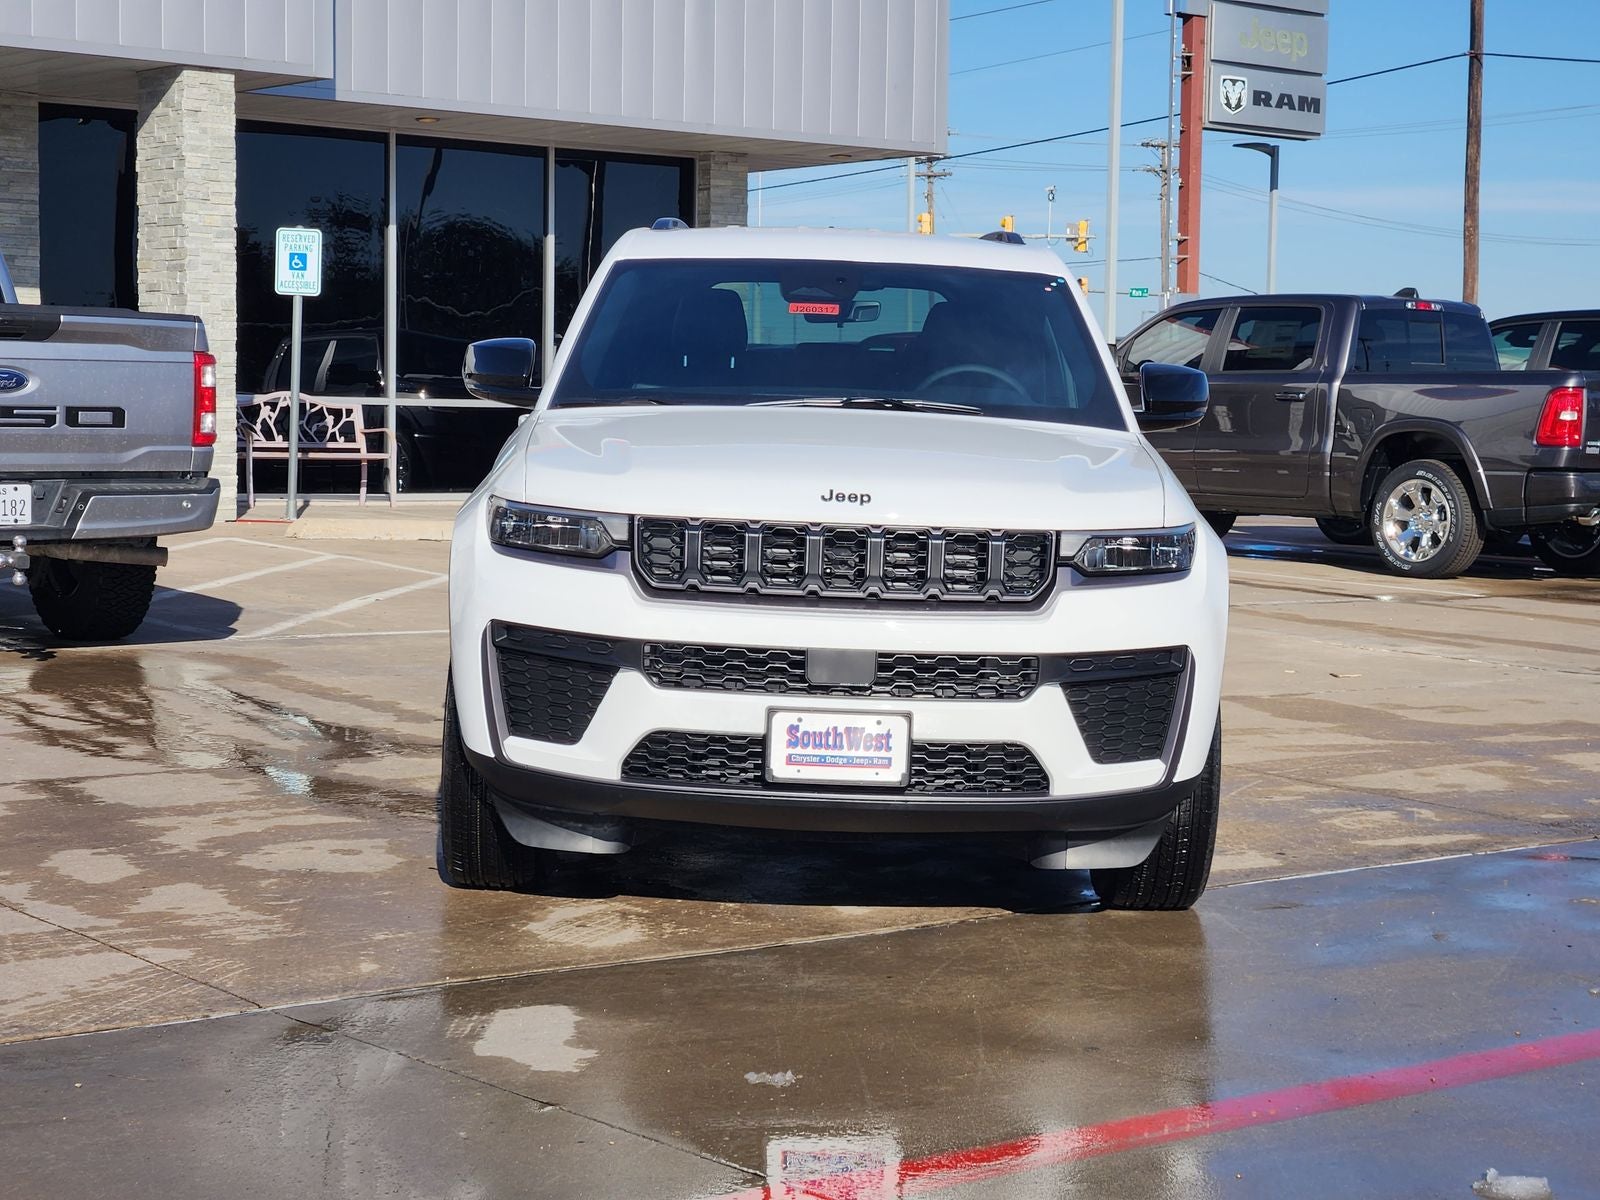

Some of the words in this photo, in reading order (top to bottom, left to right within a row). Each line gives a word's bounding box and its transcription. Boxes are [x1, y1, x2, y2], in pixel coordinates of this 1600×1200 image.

[1239, 16, 1309, 63] Jeep
[1252, 90, 1321, 114] RAM
[282, 234, 316, 243] RESERVED
[285, 243, 313, 252] PARKING
[292, 271, 305, 280] VAN
[280, 280, 317, 290] ACCESSIBLE
[792, 304, 837, 314] J260317
[821, 489, 872, 506] Jeep
[786, 723, 893, 753] SouthWest
[791, 754, 820, 764] Chrysler
[826, 756, 848, 765] Dodge
[852, 757, 869, 766] Jeep
